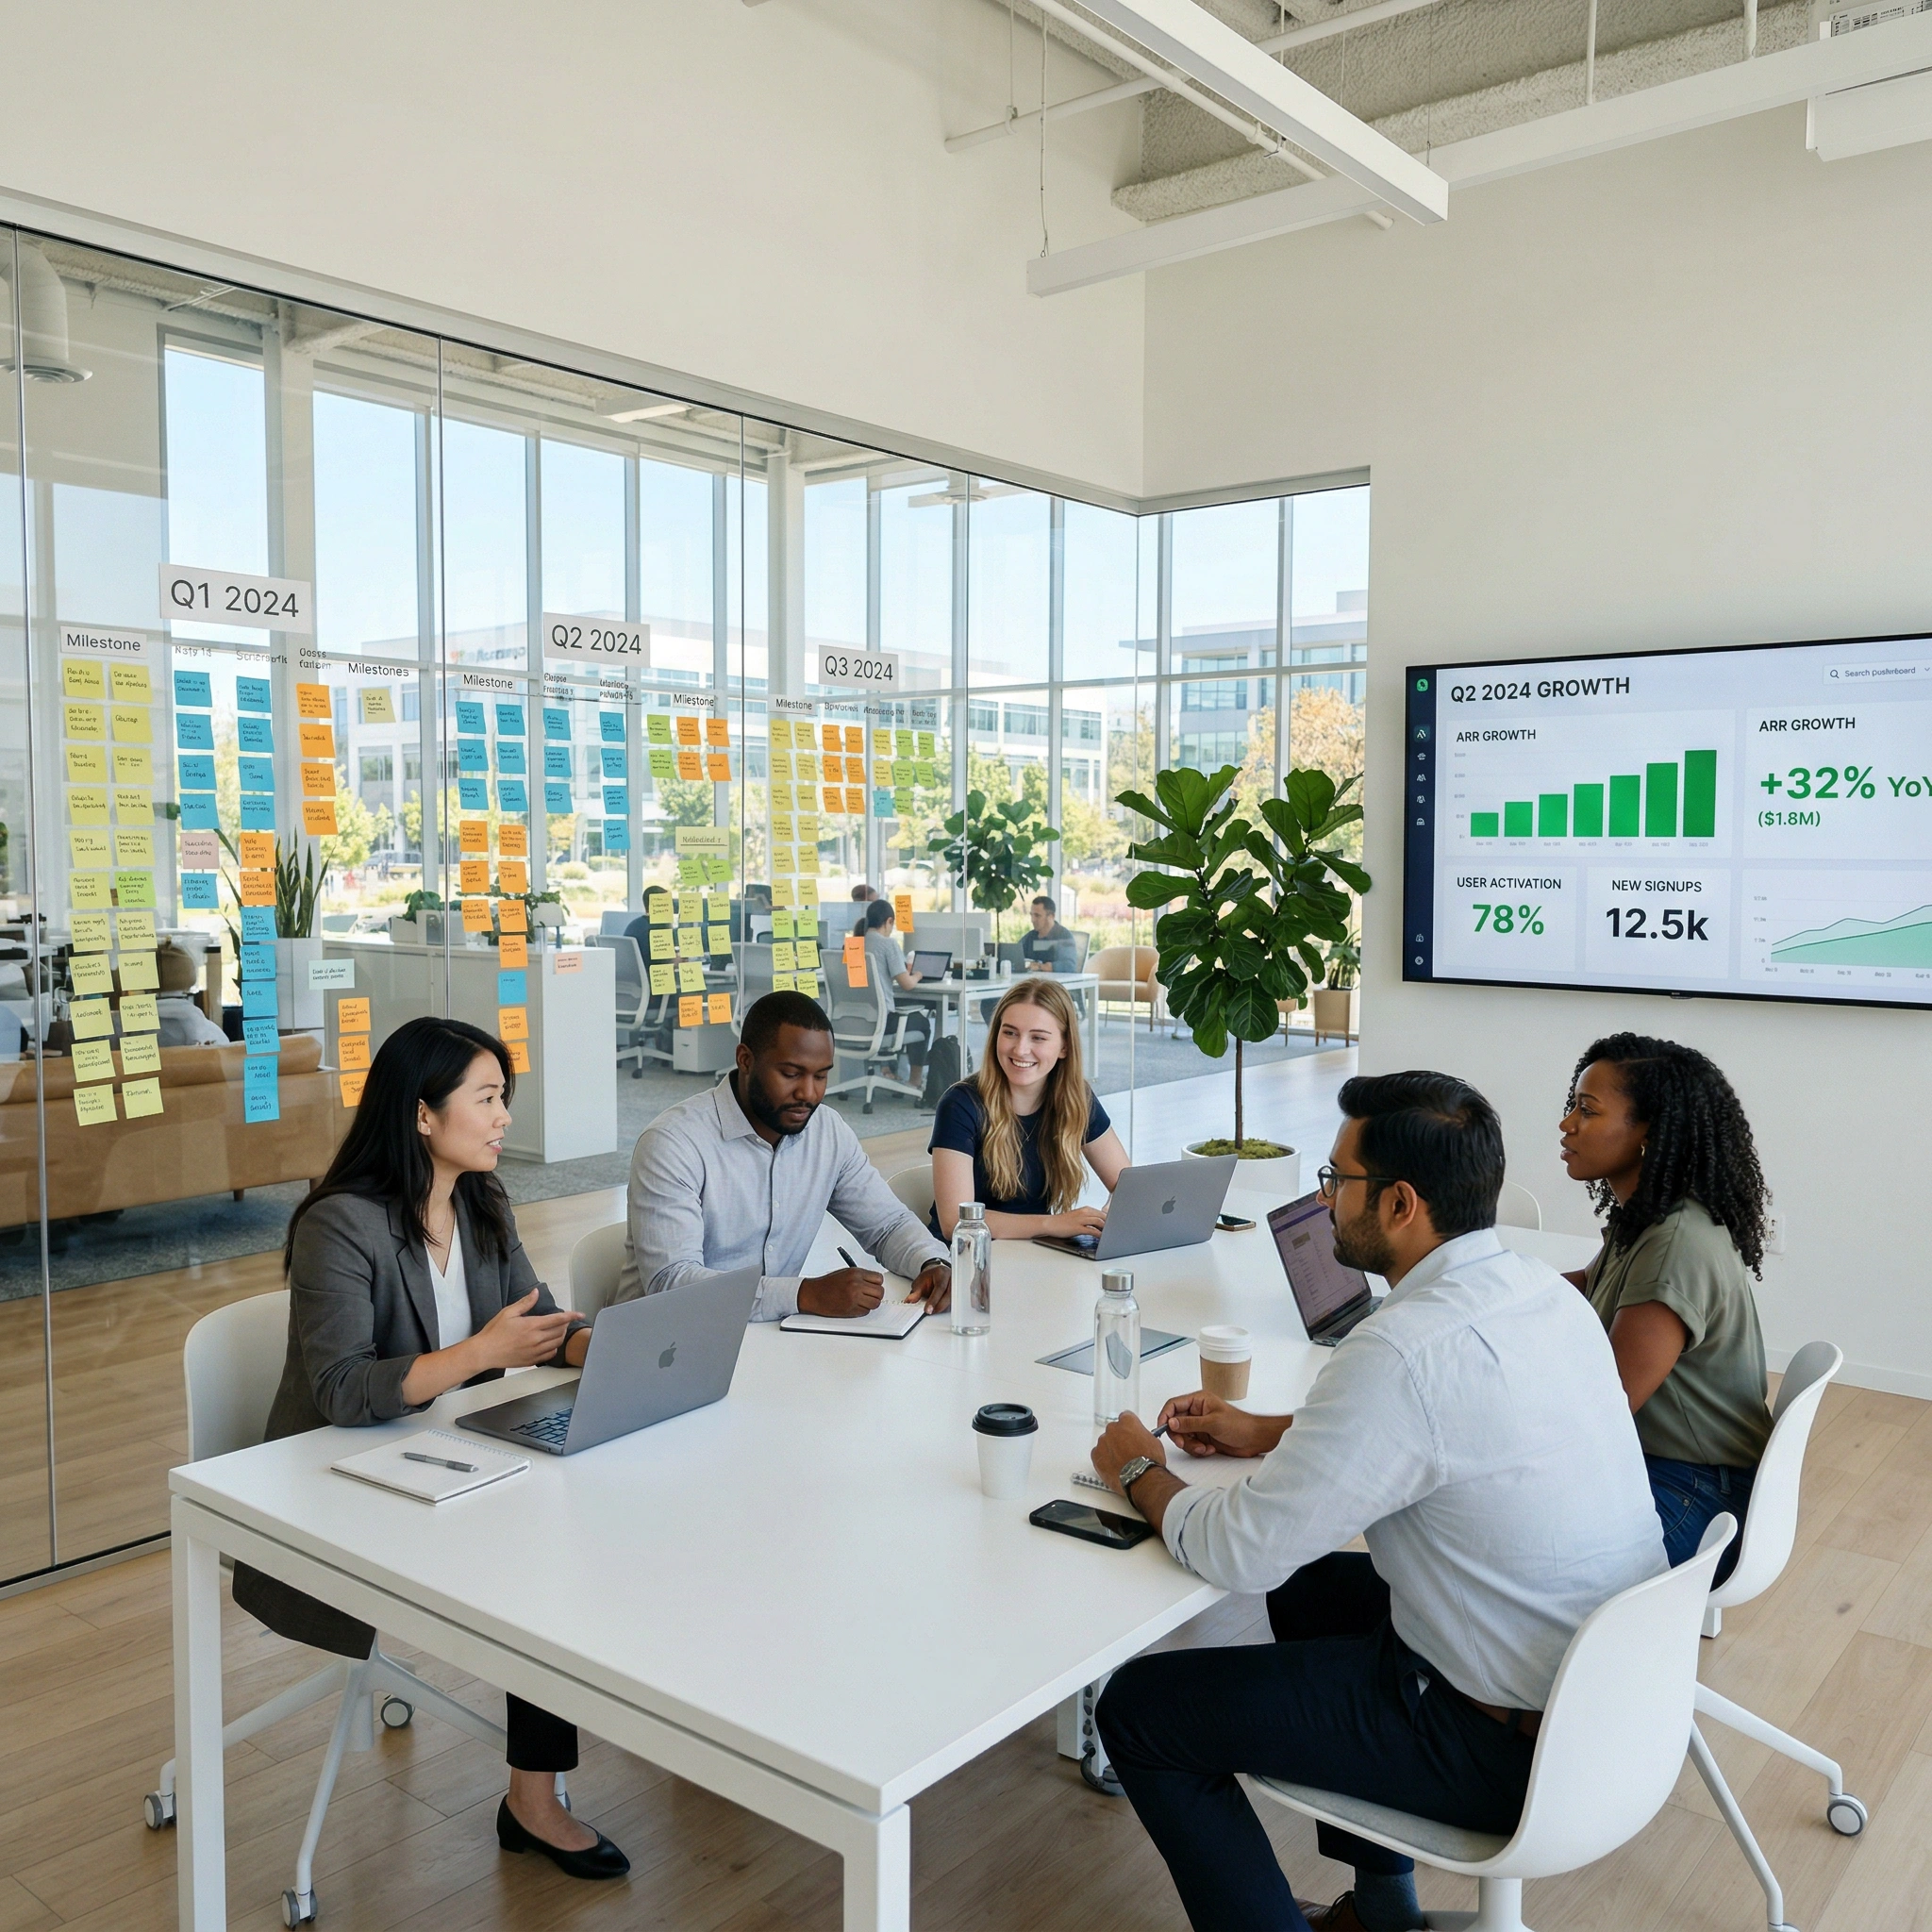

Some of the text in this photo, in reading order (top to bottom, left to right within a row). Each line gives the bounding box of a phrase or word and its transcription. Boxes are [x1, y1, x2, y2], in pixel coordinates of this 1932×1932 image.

[171, 579, 299, 618] Q1 2024
[67, 633, 141, 651] Milestone
[551, 625, 641, 655] Q2 2024
[348, 662, 409, 676] Milestones
[824, 655, 893, 681] Q3 2024
[463, 674, 513, 690] Milestone
[1451, 677, 1630, 703] Q2 2024 GROWTH
[775, 698, 812, 710] Milestone
[1758, 717, 1856, 732] ARR GROWTH
[1457, 729, 1536, 742] ARR GROWTH
[1760, 765, 1875, 799] +32%
[1757, 810, 1821, 827] ($1.8M)
[1457, 877, 1561, 890] USER ACTIVATION
[1611, 880, 1702, 892] NEW SIGNUPS
[1472, 904, 1544, 935] 78%
[1606, 908, 1708, 941] 12.5k
